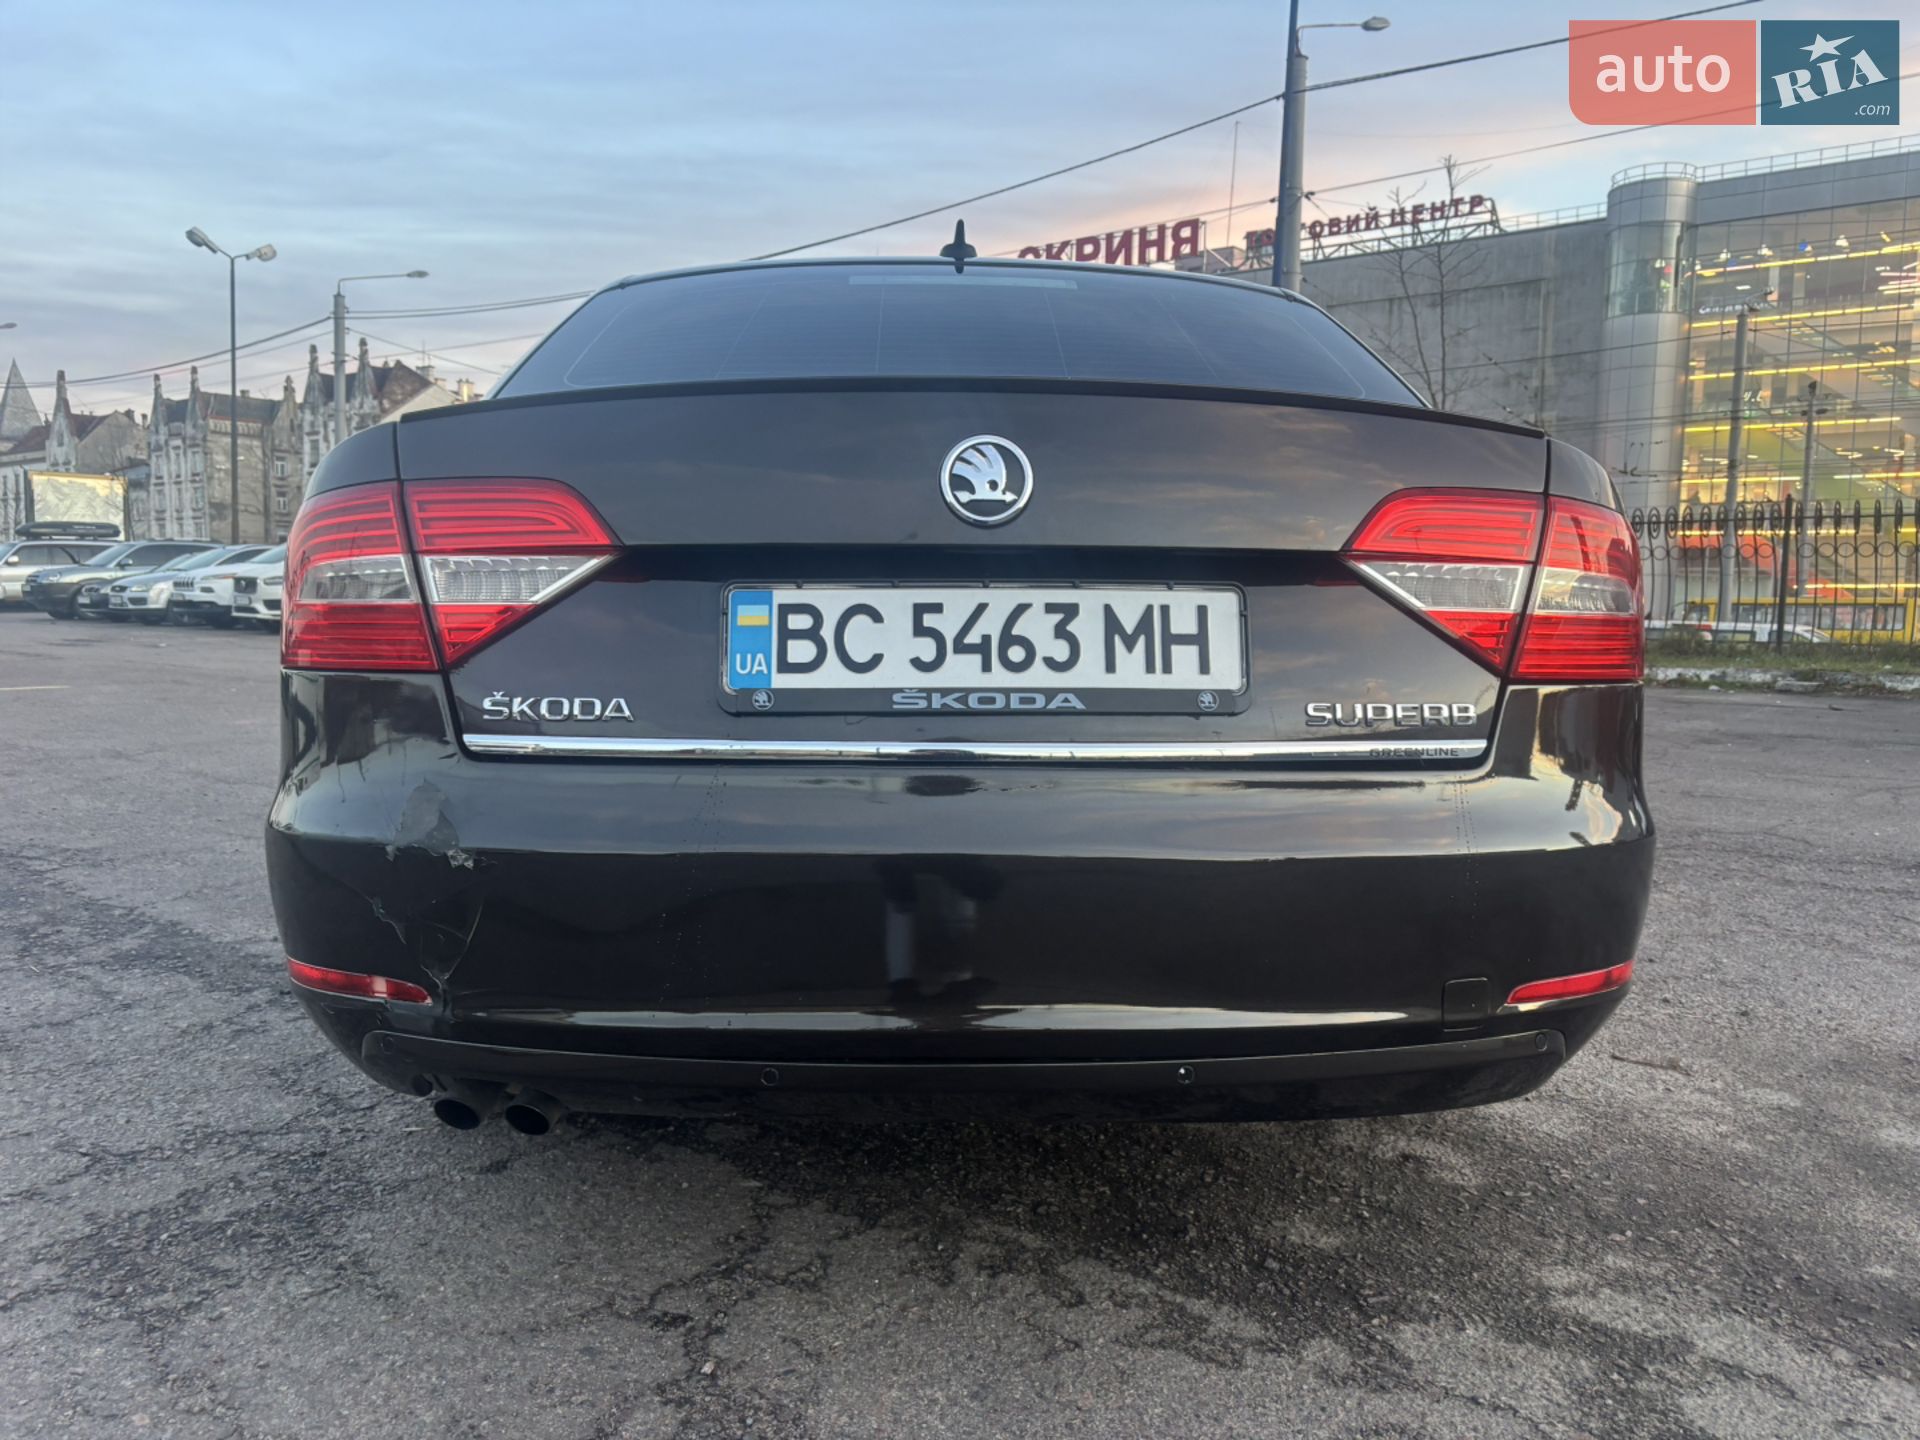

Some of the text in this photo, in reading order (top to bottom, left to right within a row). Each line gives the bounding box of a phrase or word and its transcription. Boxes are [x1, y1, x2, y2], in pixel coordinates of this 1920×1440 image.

[1246, 194, 1485, 248] ТООВИЙ ЦЕНТР
[776, 602, 1211, 675] BC 5463 MH
[735, 652, 769, 675] UA
[482, 690, 635, 721] ŠKODA
[892, 687, 1087, 710] ŠKODA
[1305, 702, 1478, 727] SUPERB
[1369, 747, 1460, 757] GREENLINE
